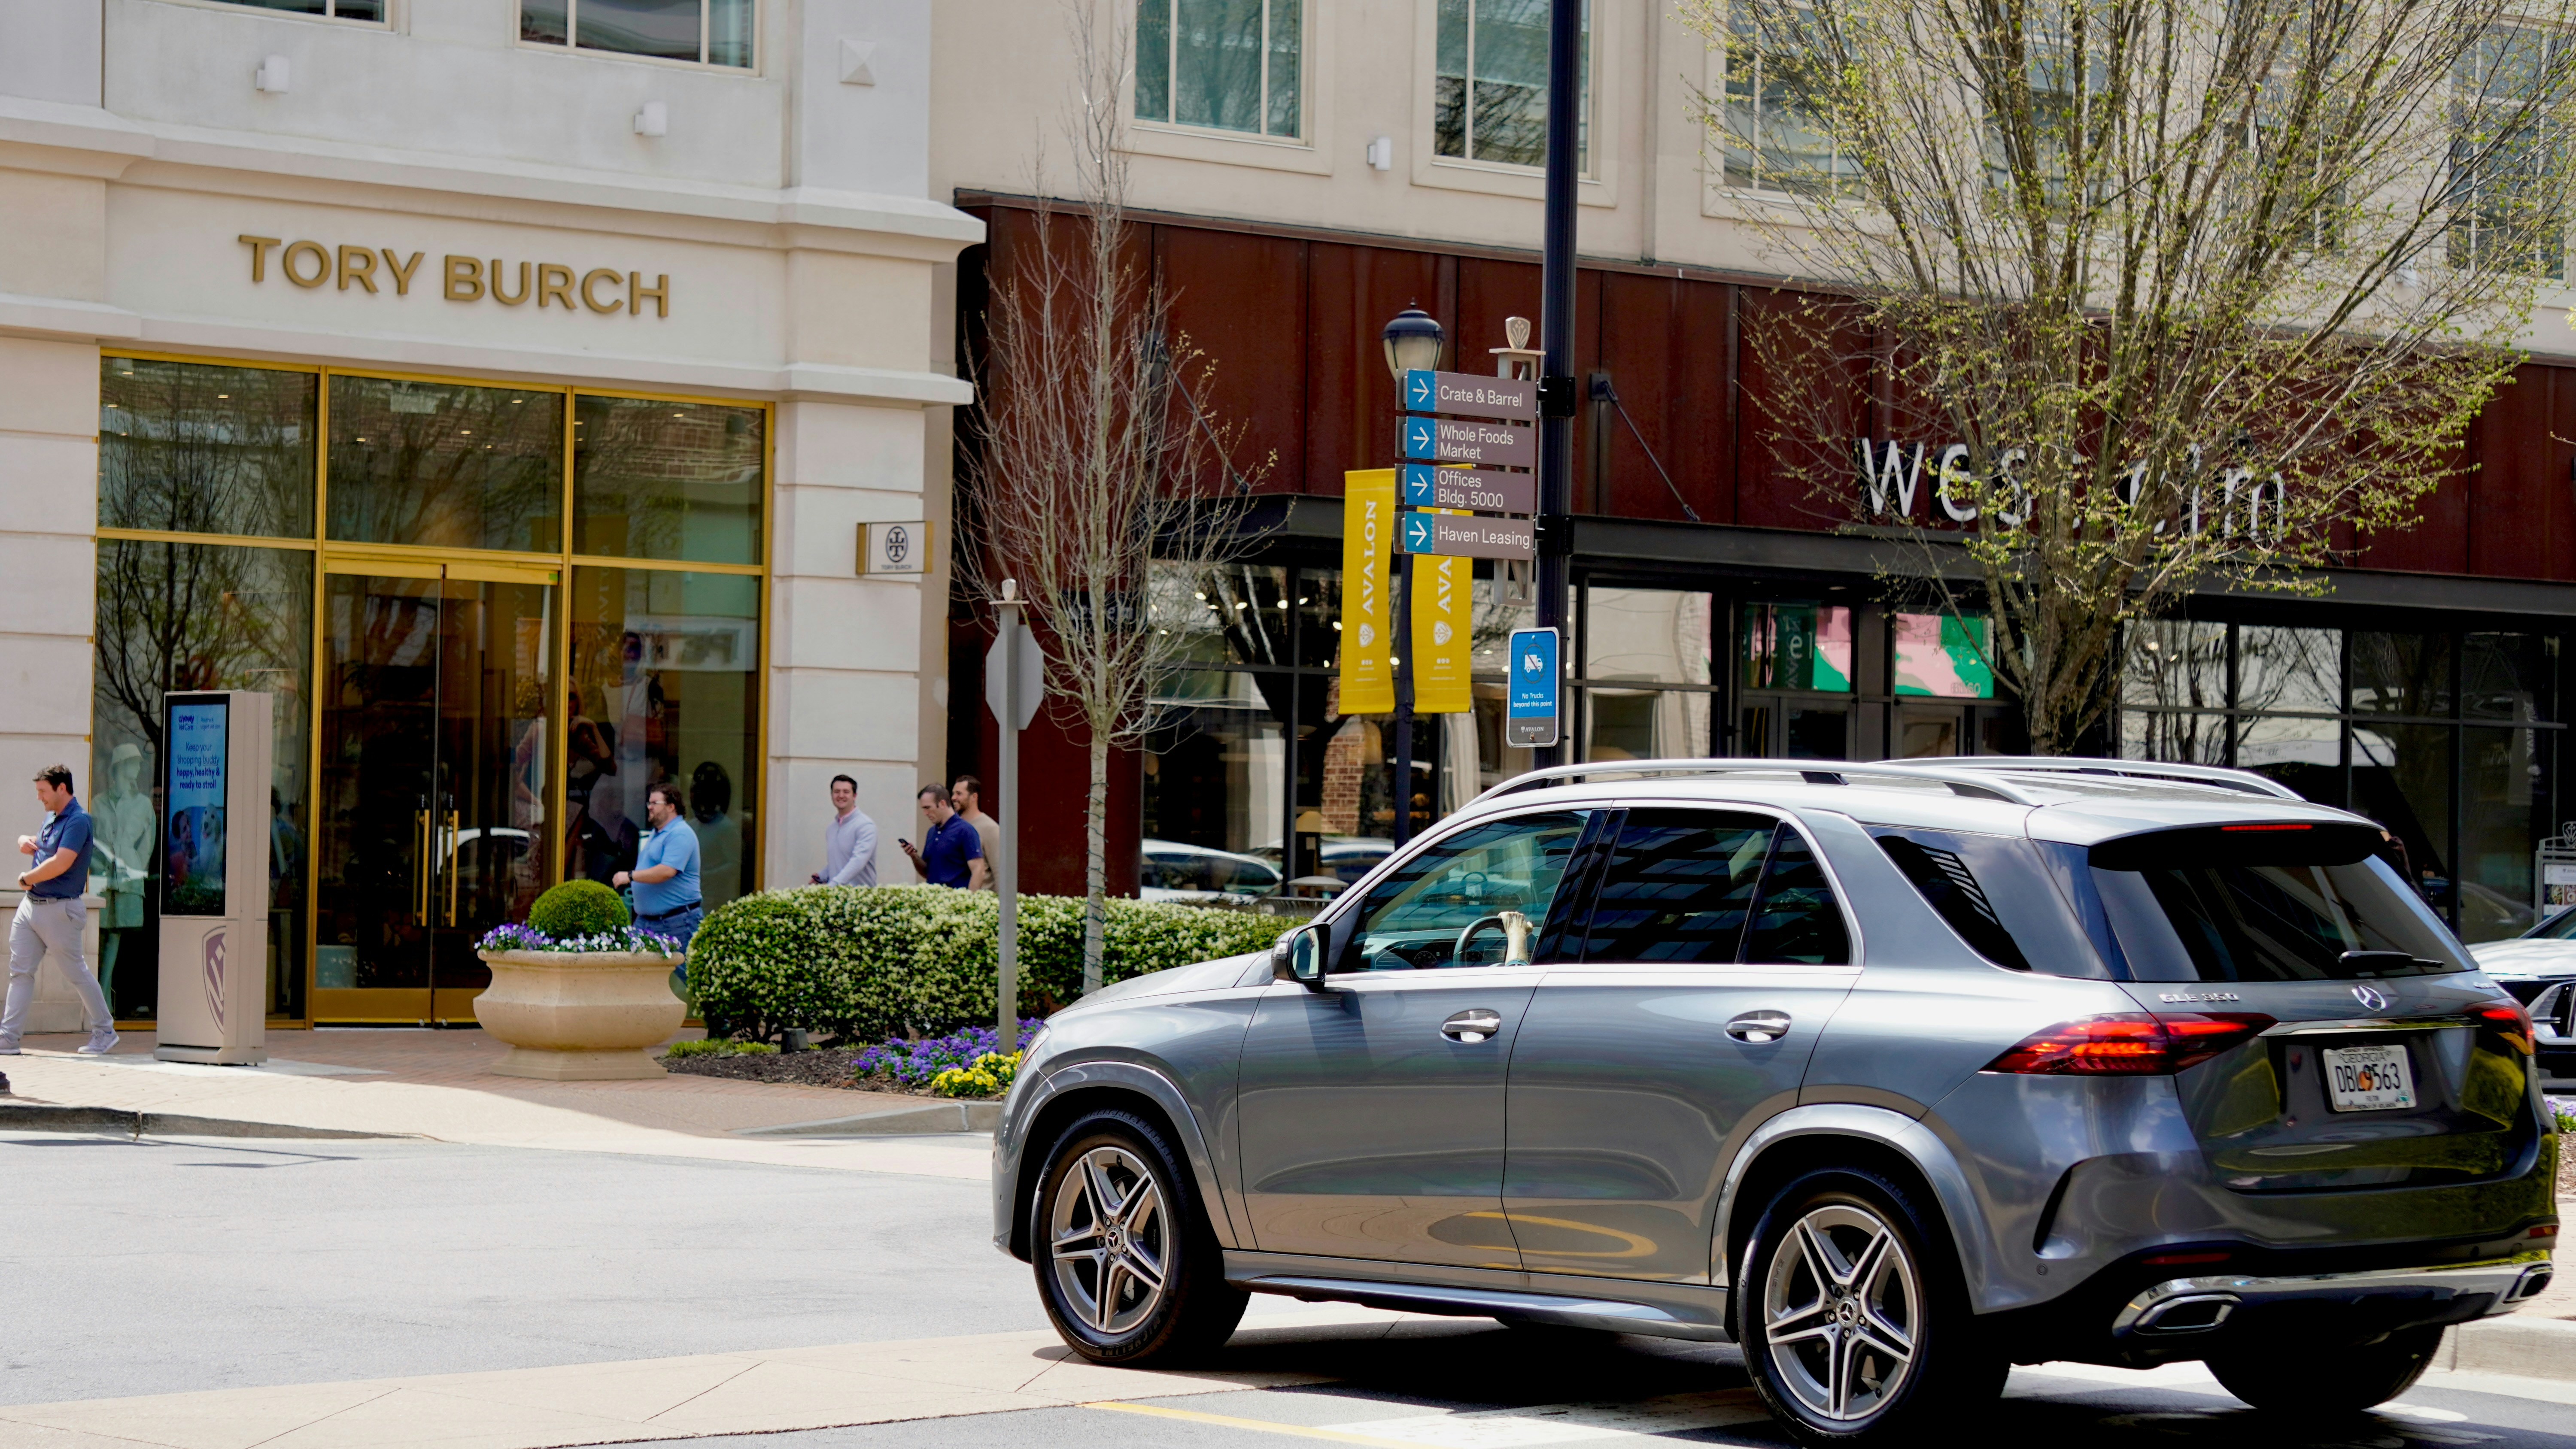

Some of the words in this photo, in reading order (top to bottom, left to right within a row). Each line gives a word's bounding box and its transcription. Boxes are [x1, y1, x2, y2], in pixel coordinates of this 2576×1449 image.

[238, 234, 425, 296] TORY
[444, 254, 669, 318] BURCH
[1440, 385, 1473, 402] Crate
[1476, 389, 1485, 403] &
[1488, 390, 1522, 407] Barrel
[1440, 424, 1476, 442] Whole
[1479, 428, 1513, 445] Foods
[1440, 442, 1481, 459] Market
[1439, 470, 1481, 488] Offices
[1855, 437, 2082, 528] wes
[1439, 488, 1467, 507] Bldg.
[1470, 491, 1503, 507] 5000
[1439, 525, 1478, 543] Haven
[1482, 528, 1530, 549] Leasing
[1363, 500, 1377, 615] AVALON
[179, 714, 194, 724] chewy
[186, 742, 199, 754] Keep
[200, 744, 212, 754] your
[177, 755, 201, 767] shopping
[203, 754, 219, 765] buddy
[176, 767, 194, 779] happy,
[195, 766, 215, 779] healthy
[216, 767, 220, 776] &
[179, 779, 194, 791] ready
[196, 780, 201, 789] to
[203, 779, 216, 789] stroll
[2160, 993, 2199, 1003] GLE
[2344, 1052, 2387, 1063] GEORGIA
[2335, 1063, 2401, 1093] DBL9563
[1105, 1315, 1161, 1356] MICHELIN
